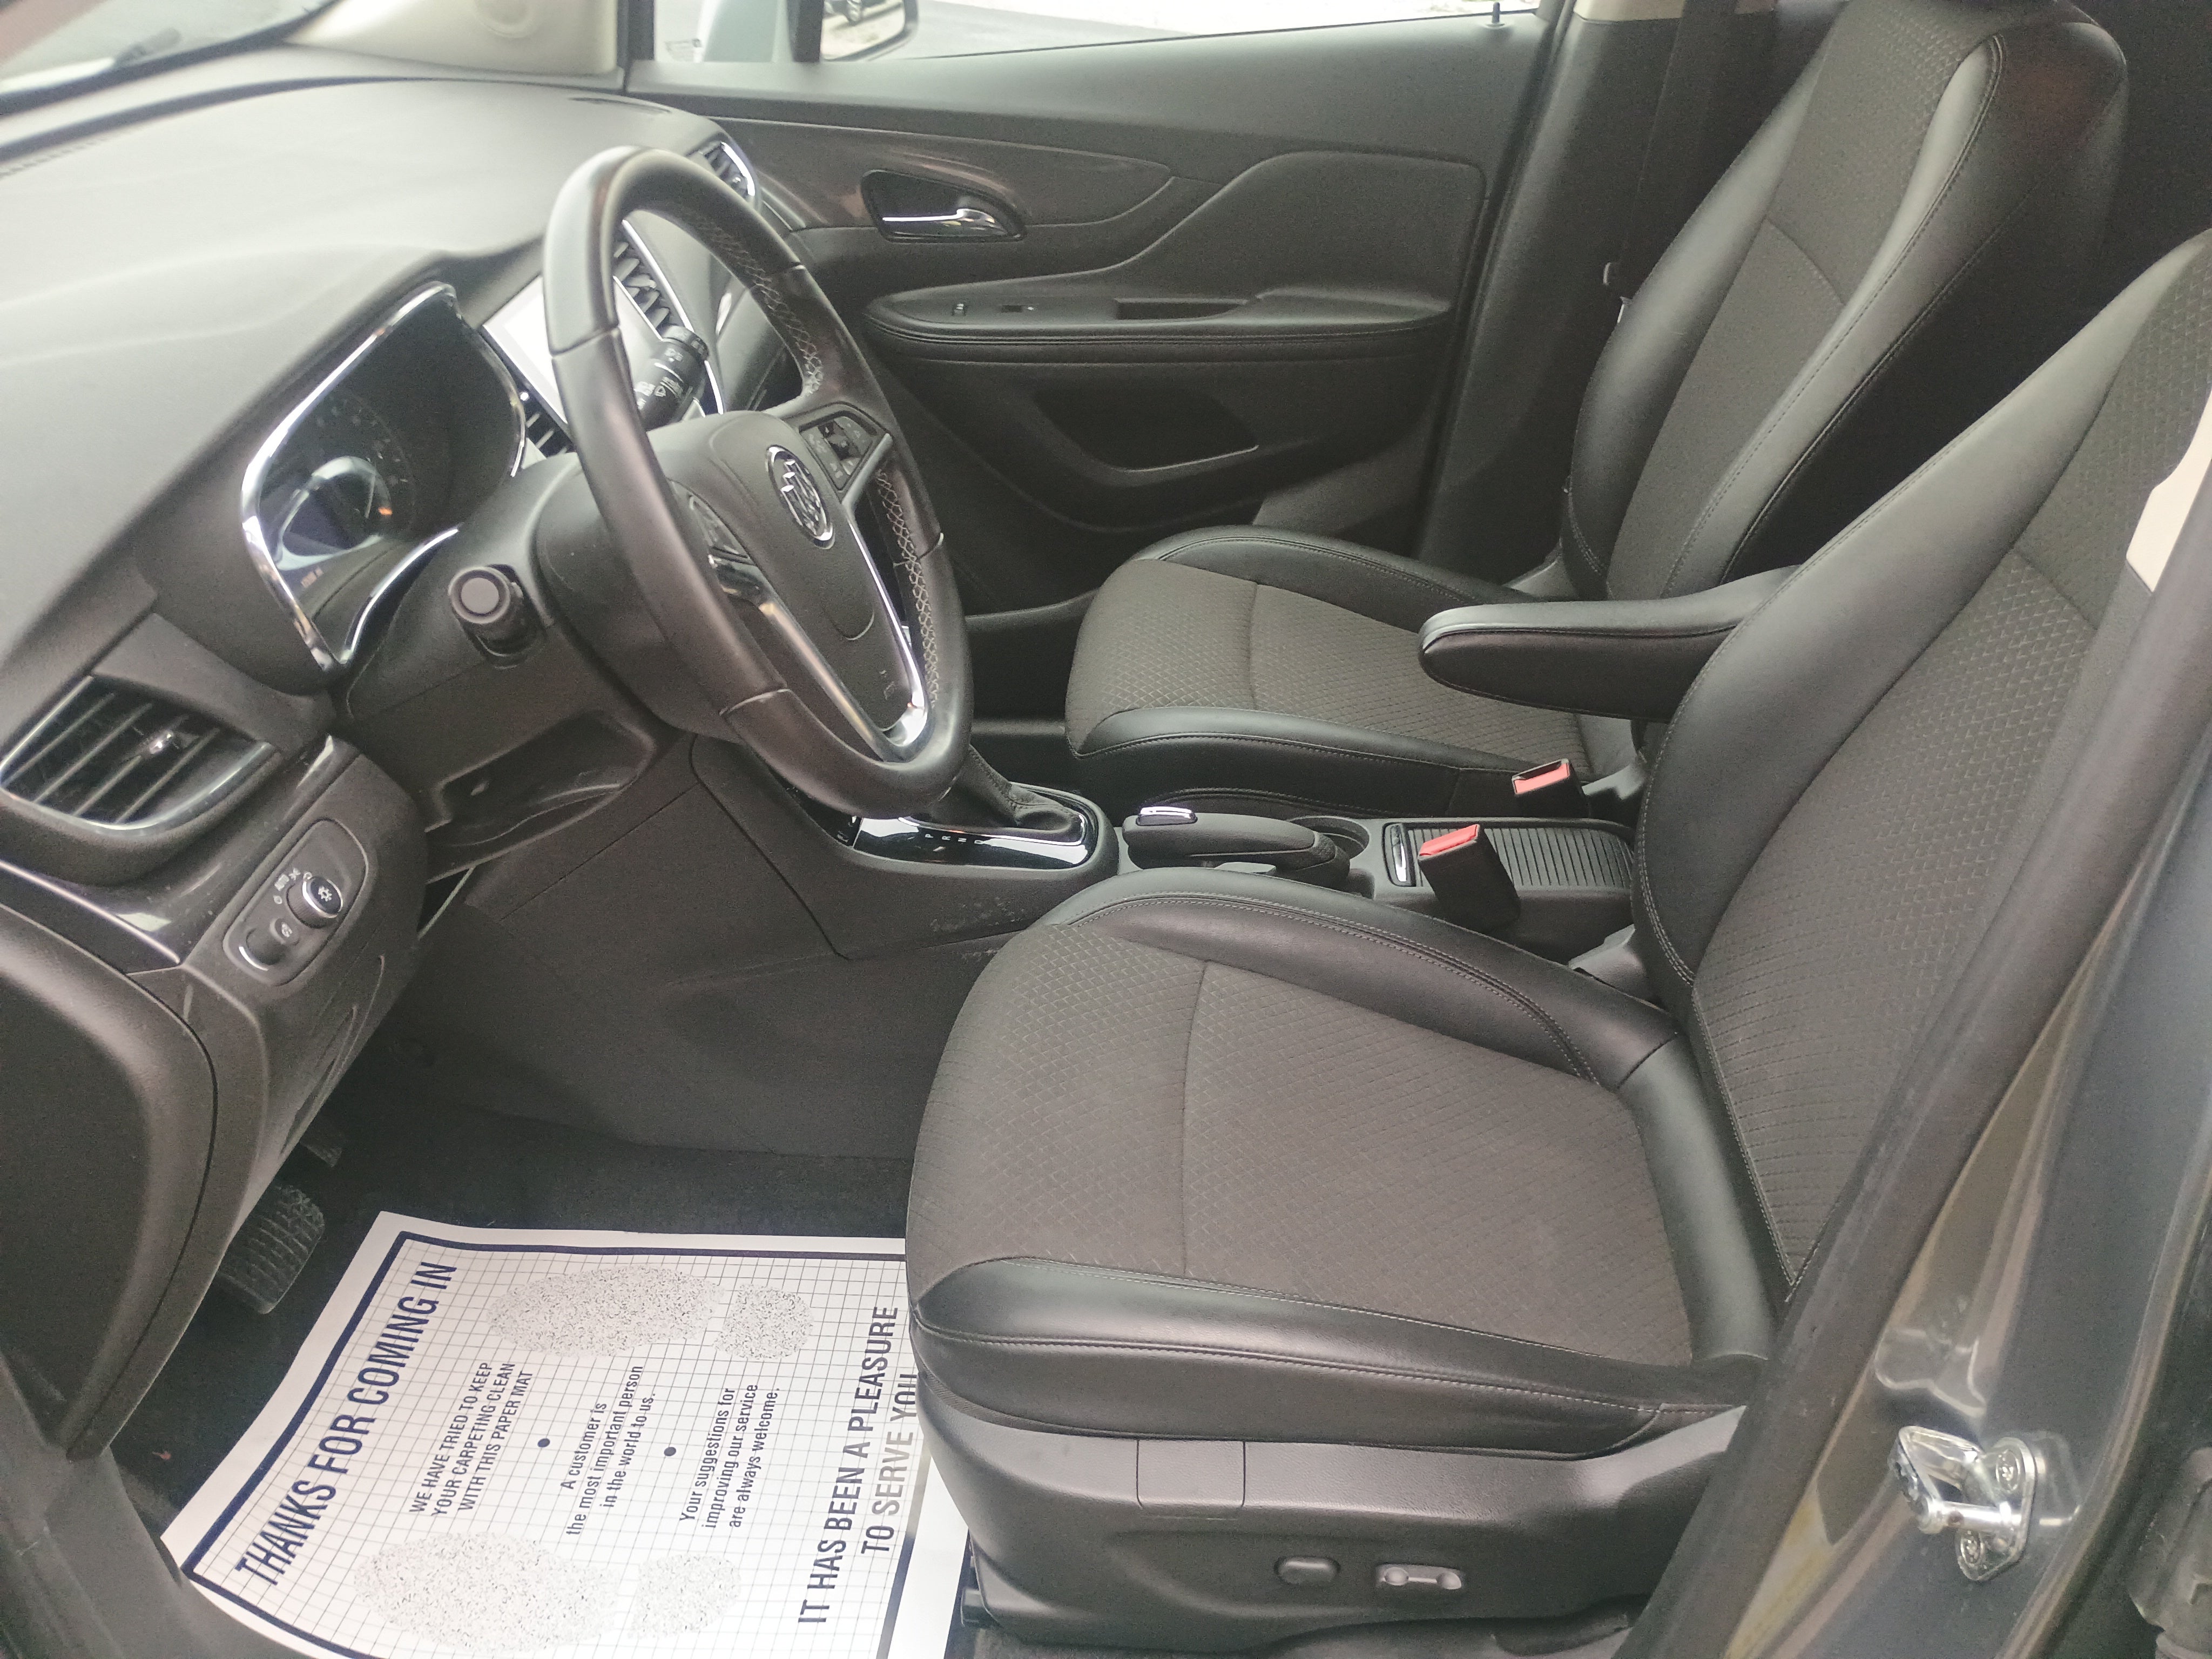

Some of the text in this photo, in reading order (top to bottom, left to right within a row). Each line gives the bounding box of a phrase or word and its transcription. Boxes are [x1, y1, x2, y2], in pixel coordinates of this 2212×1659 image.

[234, 1262, 457, 1586] THANKS FOR COMING IN
[409, 1363, 493, 1512] WE HAVE TRIED TO KEEP
[430, 1363, 515, 1516] YOUR CARPETING CLEAN
[457, 1371, 533, 1511] WITH THIS PAPER MAT
[561, 1403, 607, 1489] A customer is
[566, 1366, 643, 1535] the most important person
[599, 1393, 655, 1507] in the world to us.
[679, 1388, 735, 1521] Your suggestions for
[701, 1385, 758, 1528] improving our service
[736, 1456, 761, 1501] always
[798, 1306, 898, 1623] IT HAS BEEN A PLEASURE
[861, 1374, 918, 1554] TO SERVE YOU
[729, 1506, 745, 1528] are
